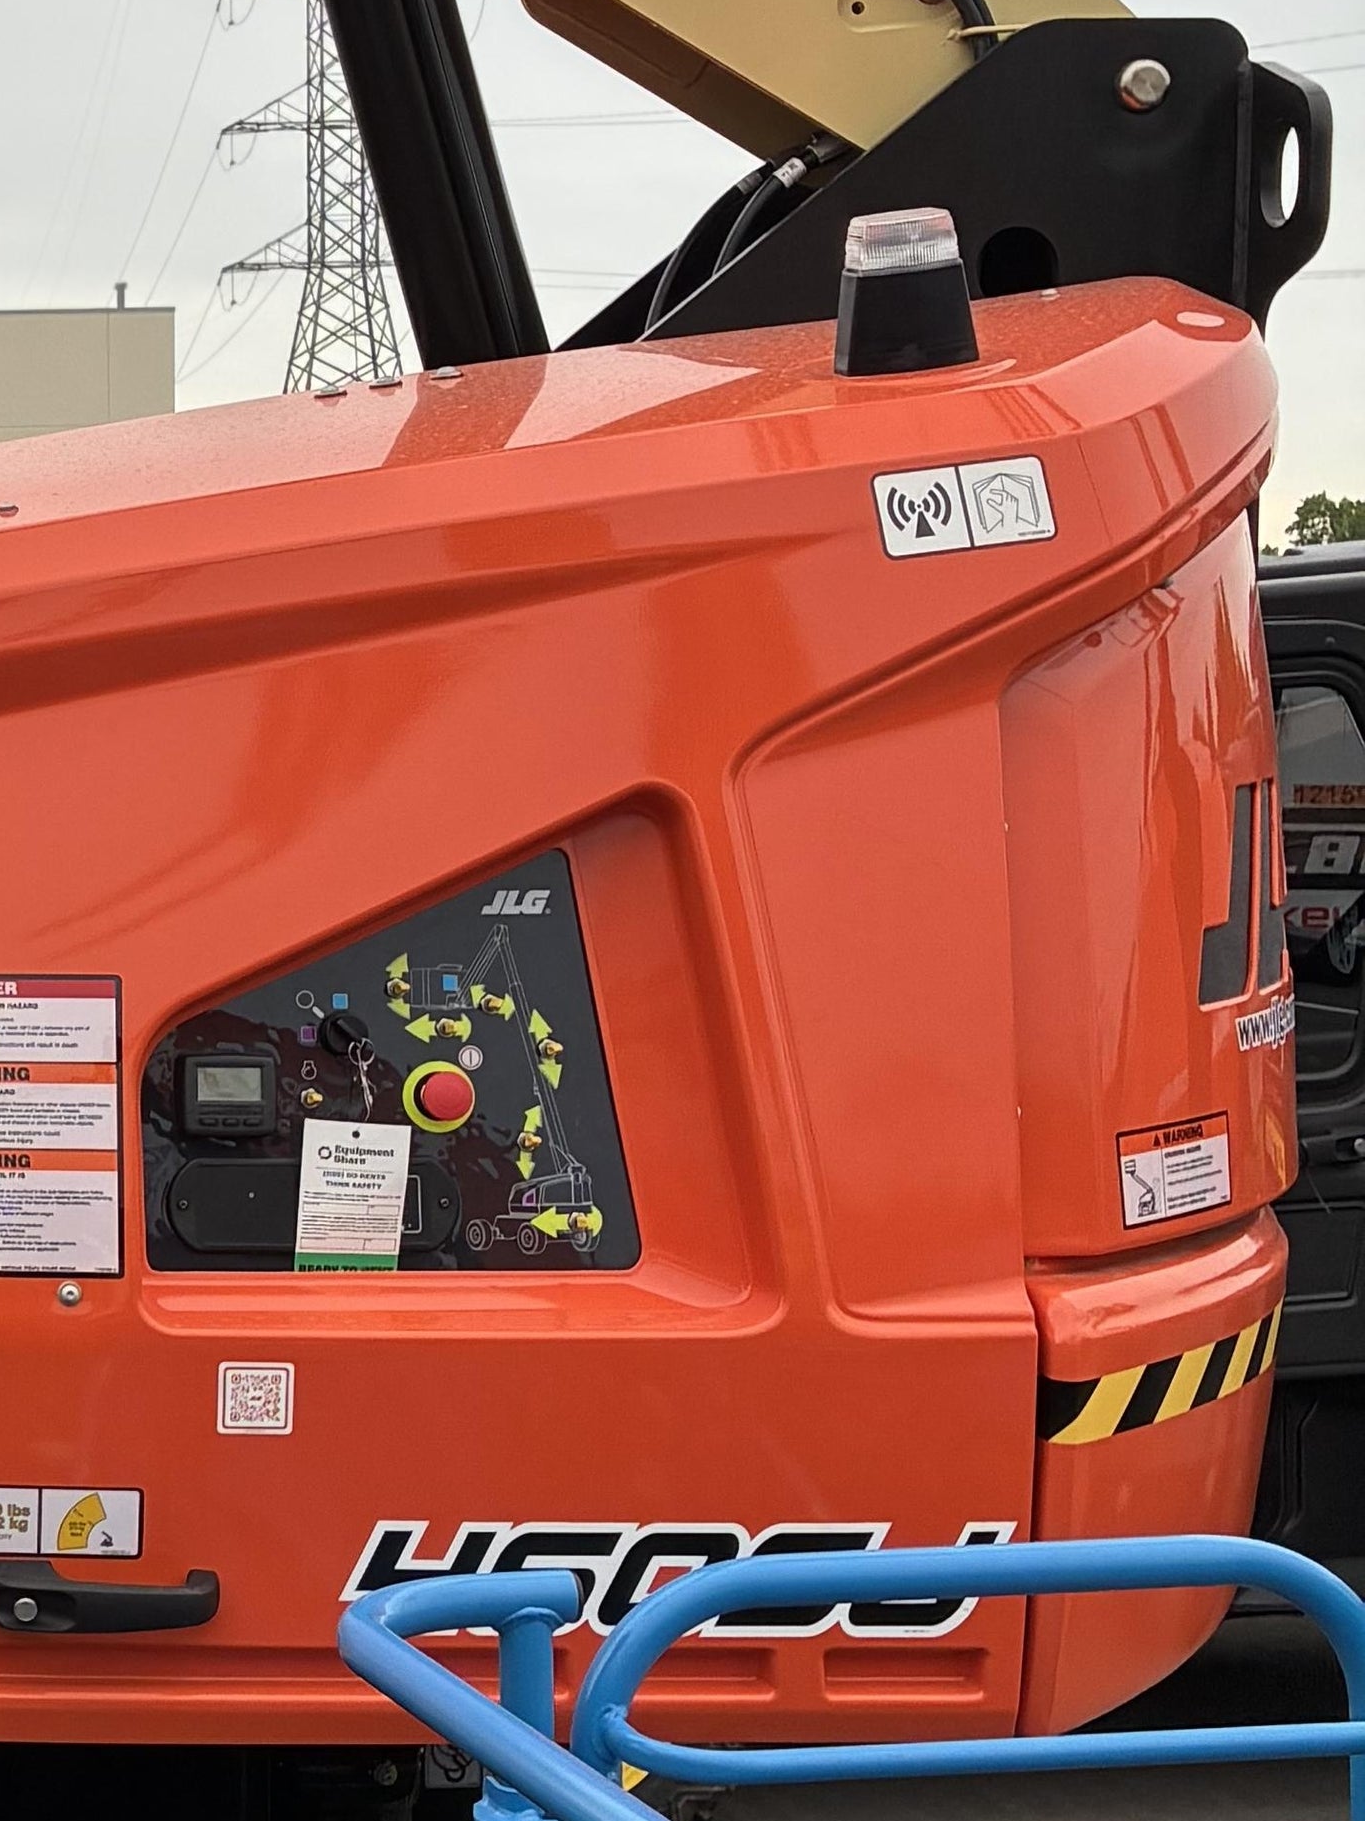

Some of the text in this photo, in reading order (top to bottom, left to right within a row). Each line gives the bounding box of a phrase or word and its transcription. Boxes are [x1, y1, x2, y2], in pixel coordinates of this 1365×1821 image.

[481, 889, 551, 915] JLG
[7, 1504, 31, 1517] lbs
[8, 1518, 29, 1533] kg
